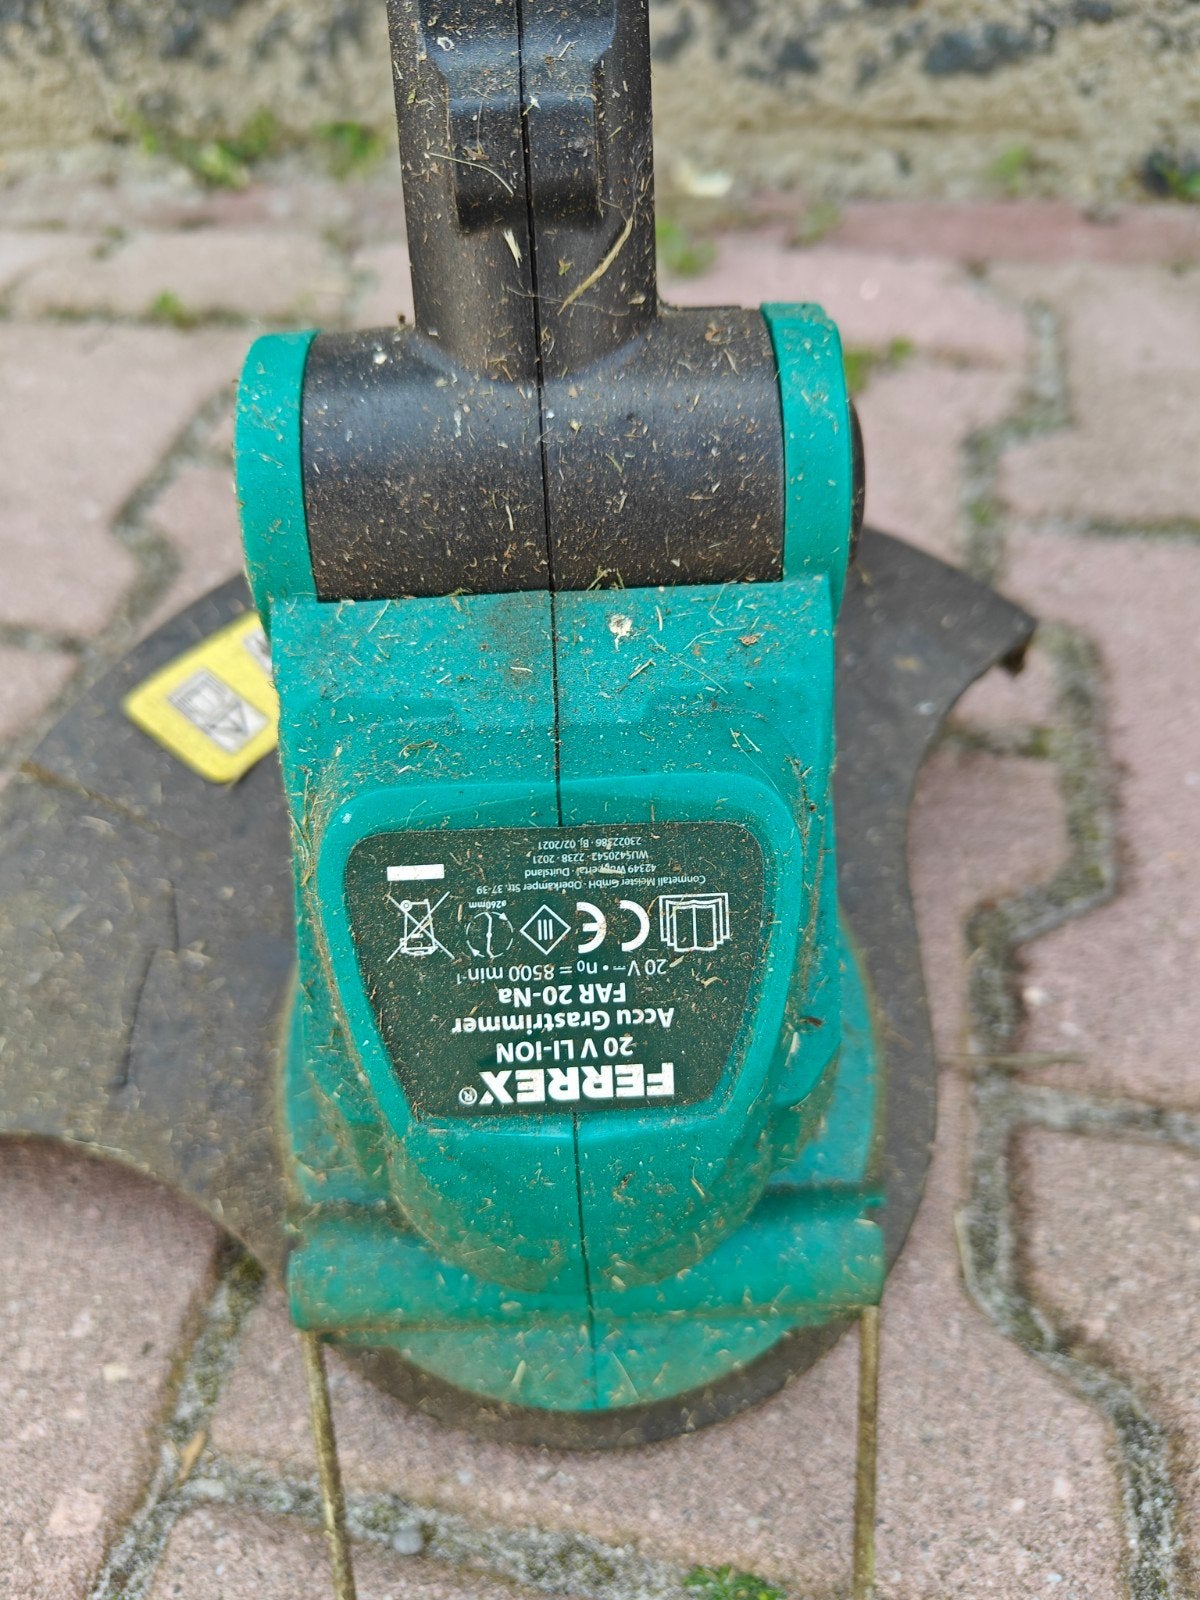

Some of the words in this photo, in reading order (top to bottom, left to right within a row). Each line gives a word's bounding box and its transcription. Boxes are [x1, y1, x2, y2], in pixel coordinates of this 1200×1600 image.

[538, 839, 576, 850] 02/2021
[532, 854, 555, 865] 2021
[561, 852, 585, 863] 2238
[524, 867, 570, 879] Duitsland
[627, 864, 657, 873] 42349
[588, 879, 620, 889] GmbH
[620, 877, 656, 887] Meister
[657, 875, 706, 886] Conmetall
[476, 884, 503, 895] 37-39
[508, 963, 555, 982] 8500
[644, 958, 667, 975] 20
[497, 984, 573, 1007] 20-Na
[578, 982, 626, 1003] FAR
[451, 1010, 610, 1035] Grastrimmer
[616, 1007, 675, 1028] Accu
[496, 1039, 574, 1063] LI-ION
[581, 1038, 598, 1059] V
[603, 1036, 634, 1057] 20
